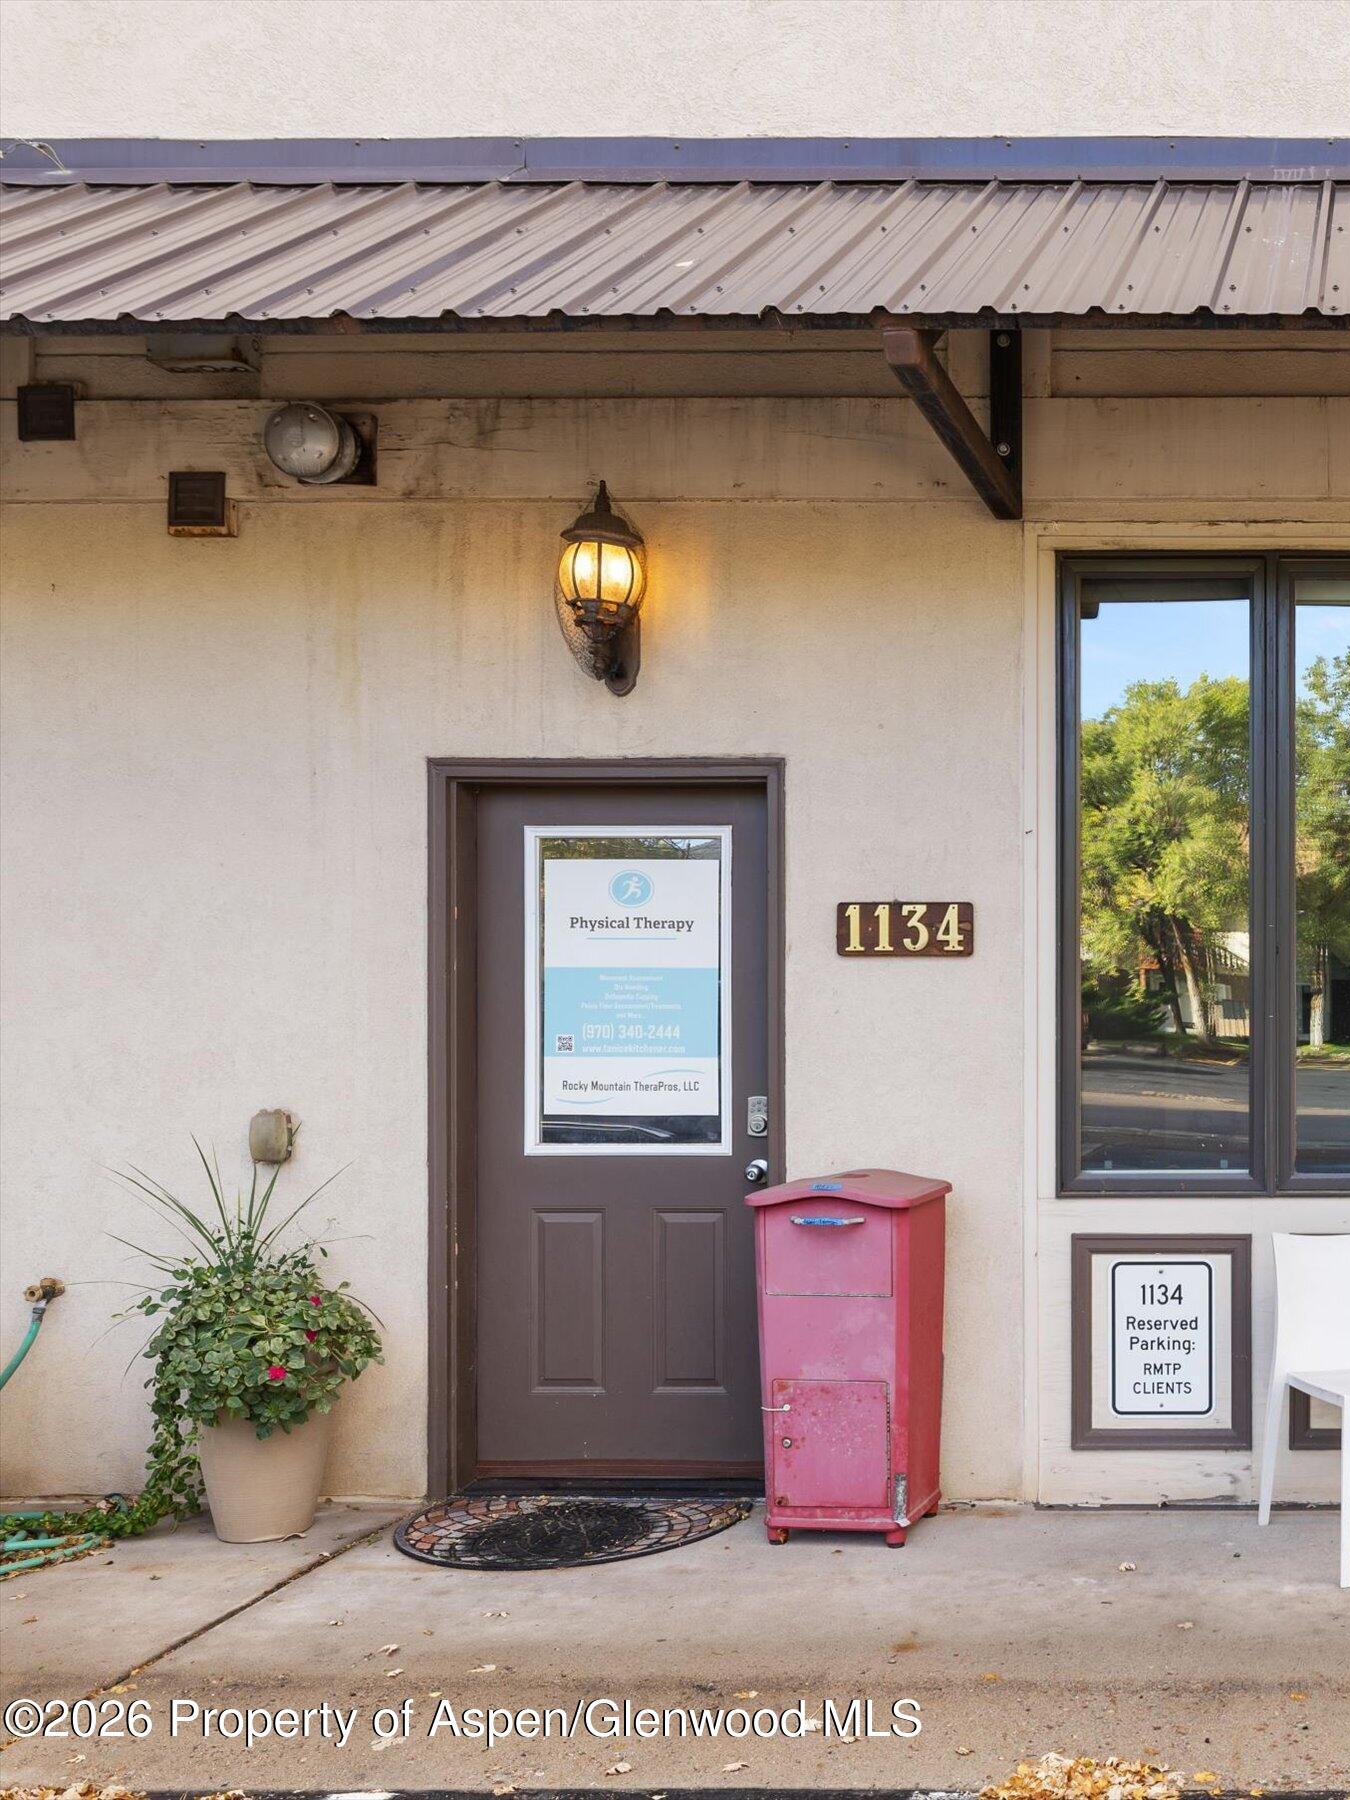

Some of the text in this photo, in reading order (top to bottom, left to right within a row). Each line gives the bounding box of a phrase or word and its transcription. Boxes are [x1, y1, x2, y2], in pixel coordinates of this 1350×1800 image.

[570, 916, 694, 932] Physical Therapy
[845, 904, 964, 952] 1134
[582, 1022, 680, 1040] (970) 340-2444
[562, 1080, 700, 1092] Rocky Mountain TheraPros, LLC
[1140, 1284, 1184, 1306] 1134
[1126, 1316, 1199, 1331] Reserved
[1129, 1337, 1196, 1355] Parking:
[1143, 1363, 1182, 1375] RMTP
[1133, 1382, 1192, 1394] CLIENTS
